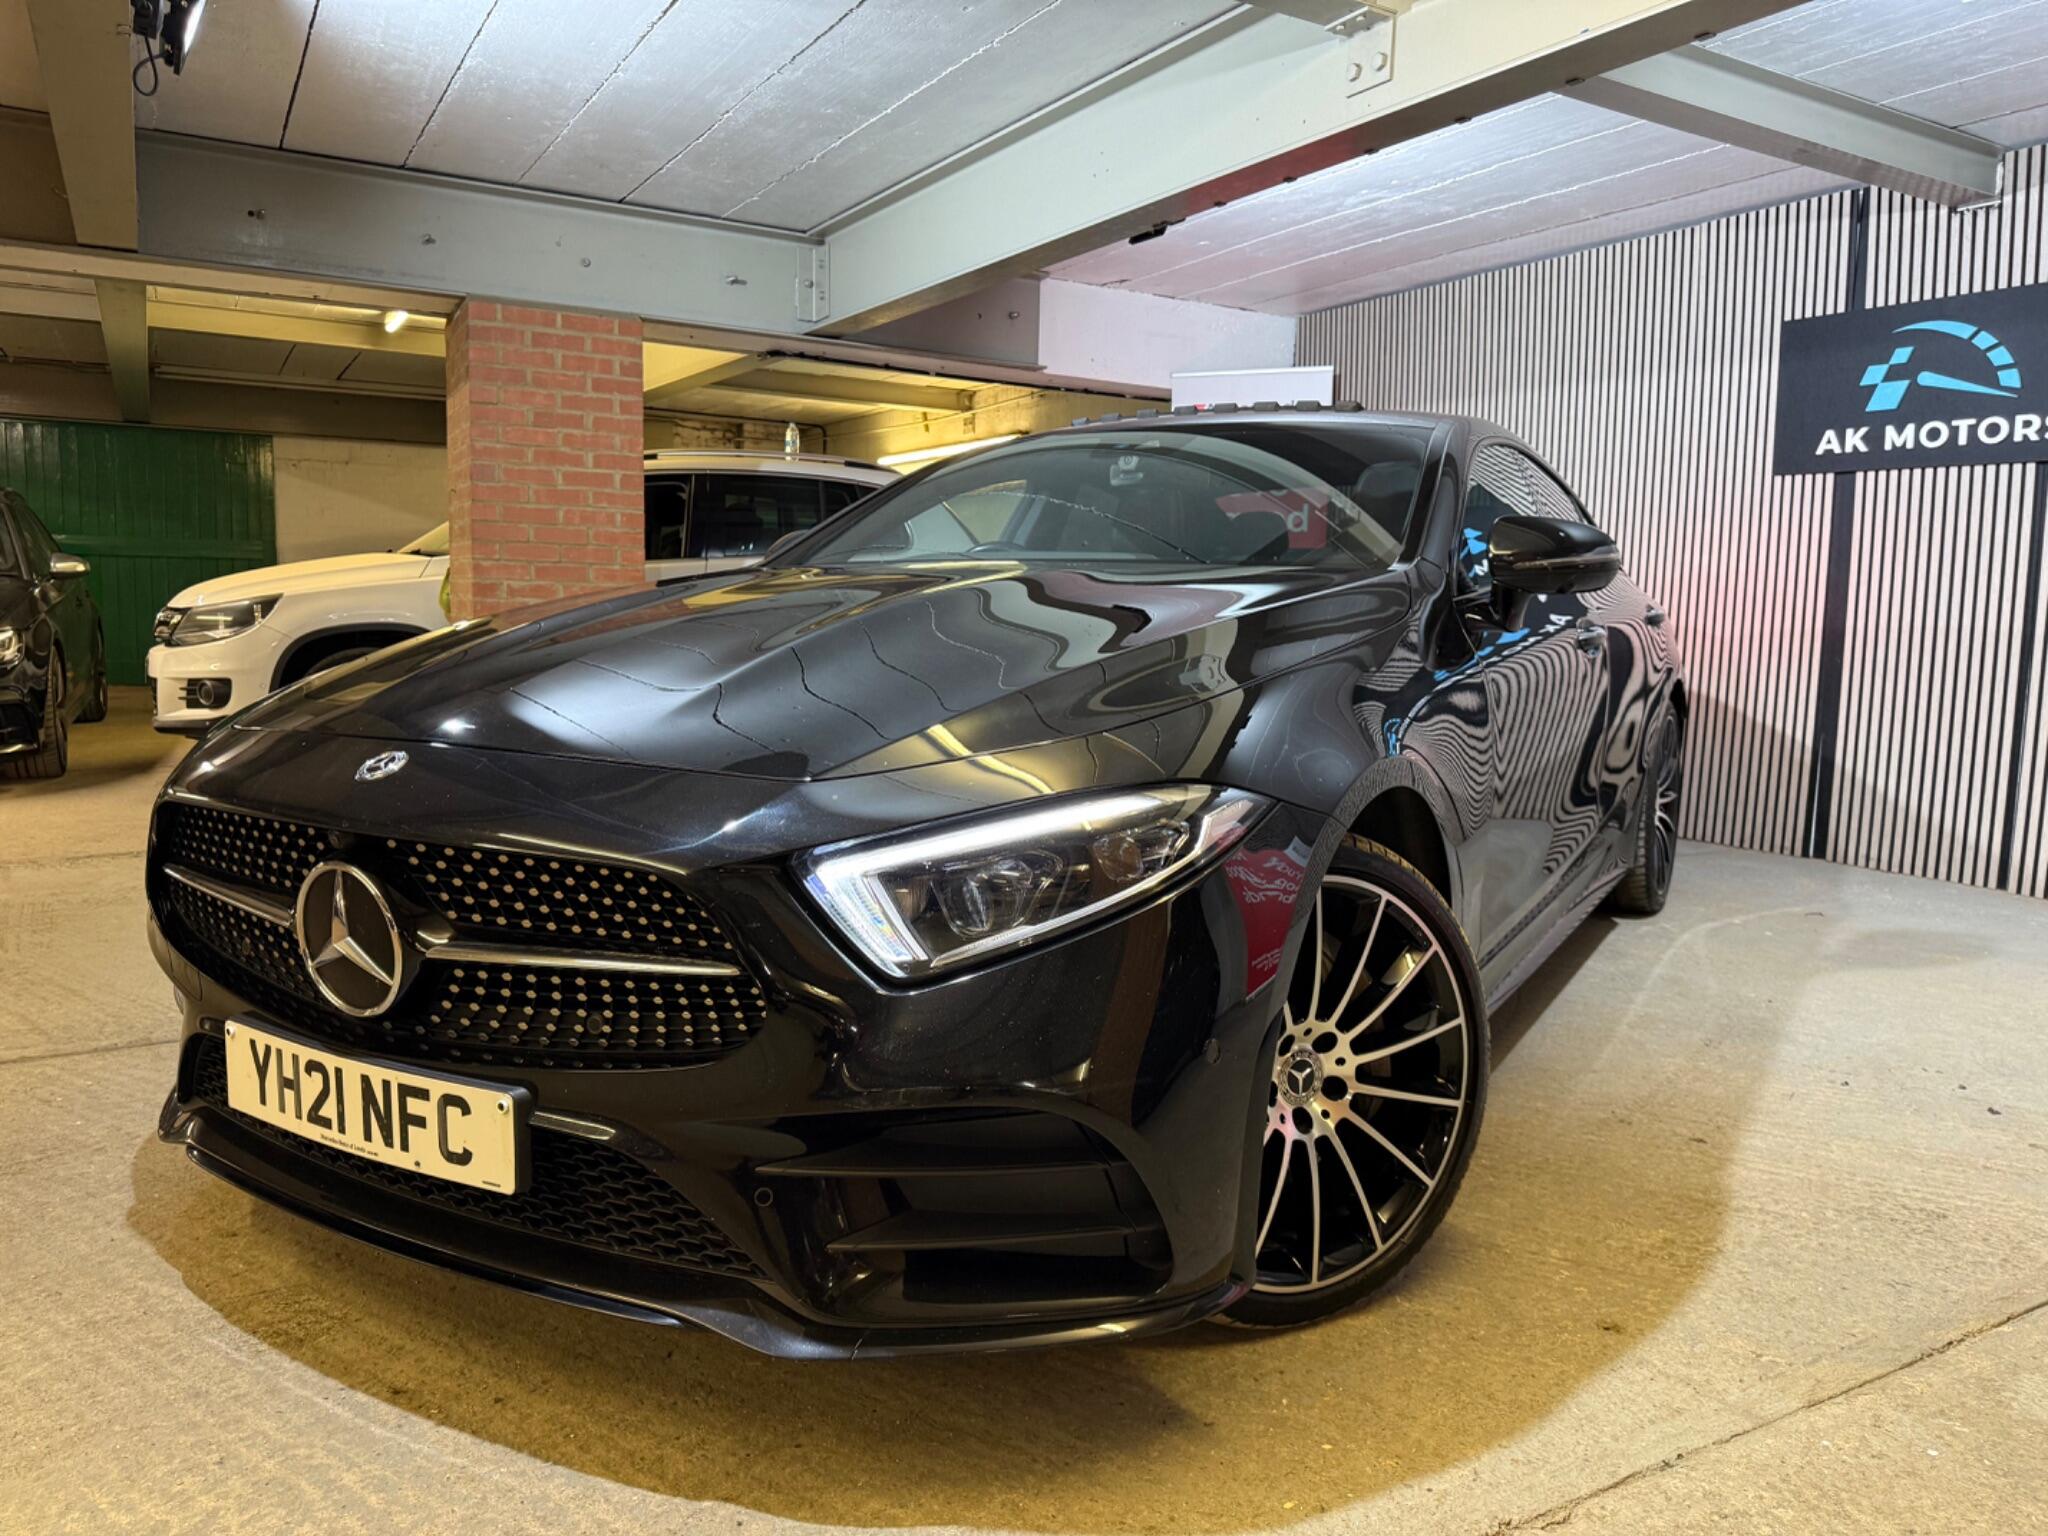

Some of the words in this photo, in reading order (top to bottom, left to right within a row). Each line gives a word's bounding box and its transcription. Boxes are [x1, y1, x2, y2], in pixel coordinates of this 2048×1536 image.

[1815, 426, 1870, 455] AK
[250, 1038, 346, 1135] YH21
[360, 1074, 473, 1167] NFC
